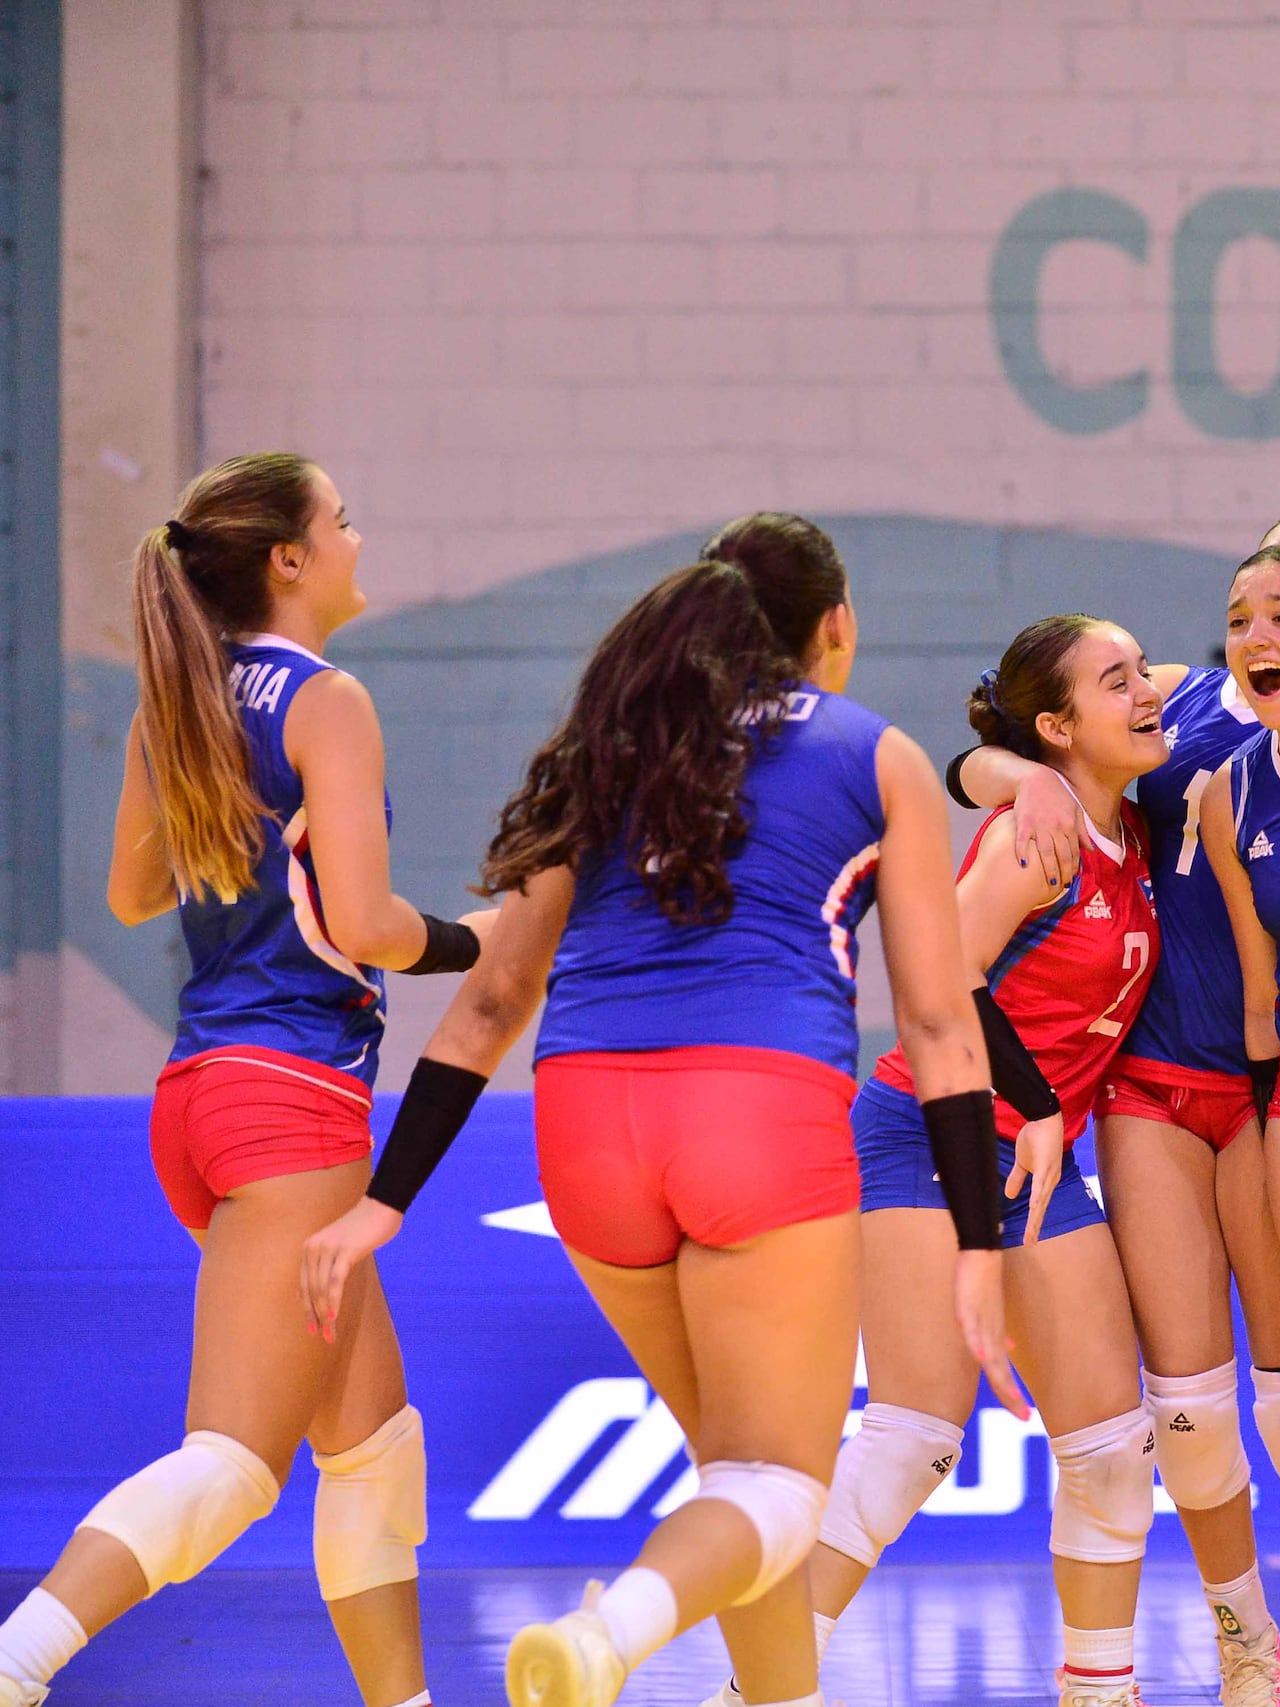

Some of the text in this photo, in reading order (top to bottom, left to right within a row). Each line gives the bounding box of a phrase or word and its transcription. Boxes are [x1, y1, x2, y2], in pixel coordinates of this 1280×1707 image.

[1247, 842, 1275, 861] PEAK
[1083, 904, 1113, 920] PEAK
[1087, 931, 1150, 1038] 2
[1168, 1422, 1196, 1433] PEAK
